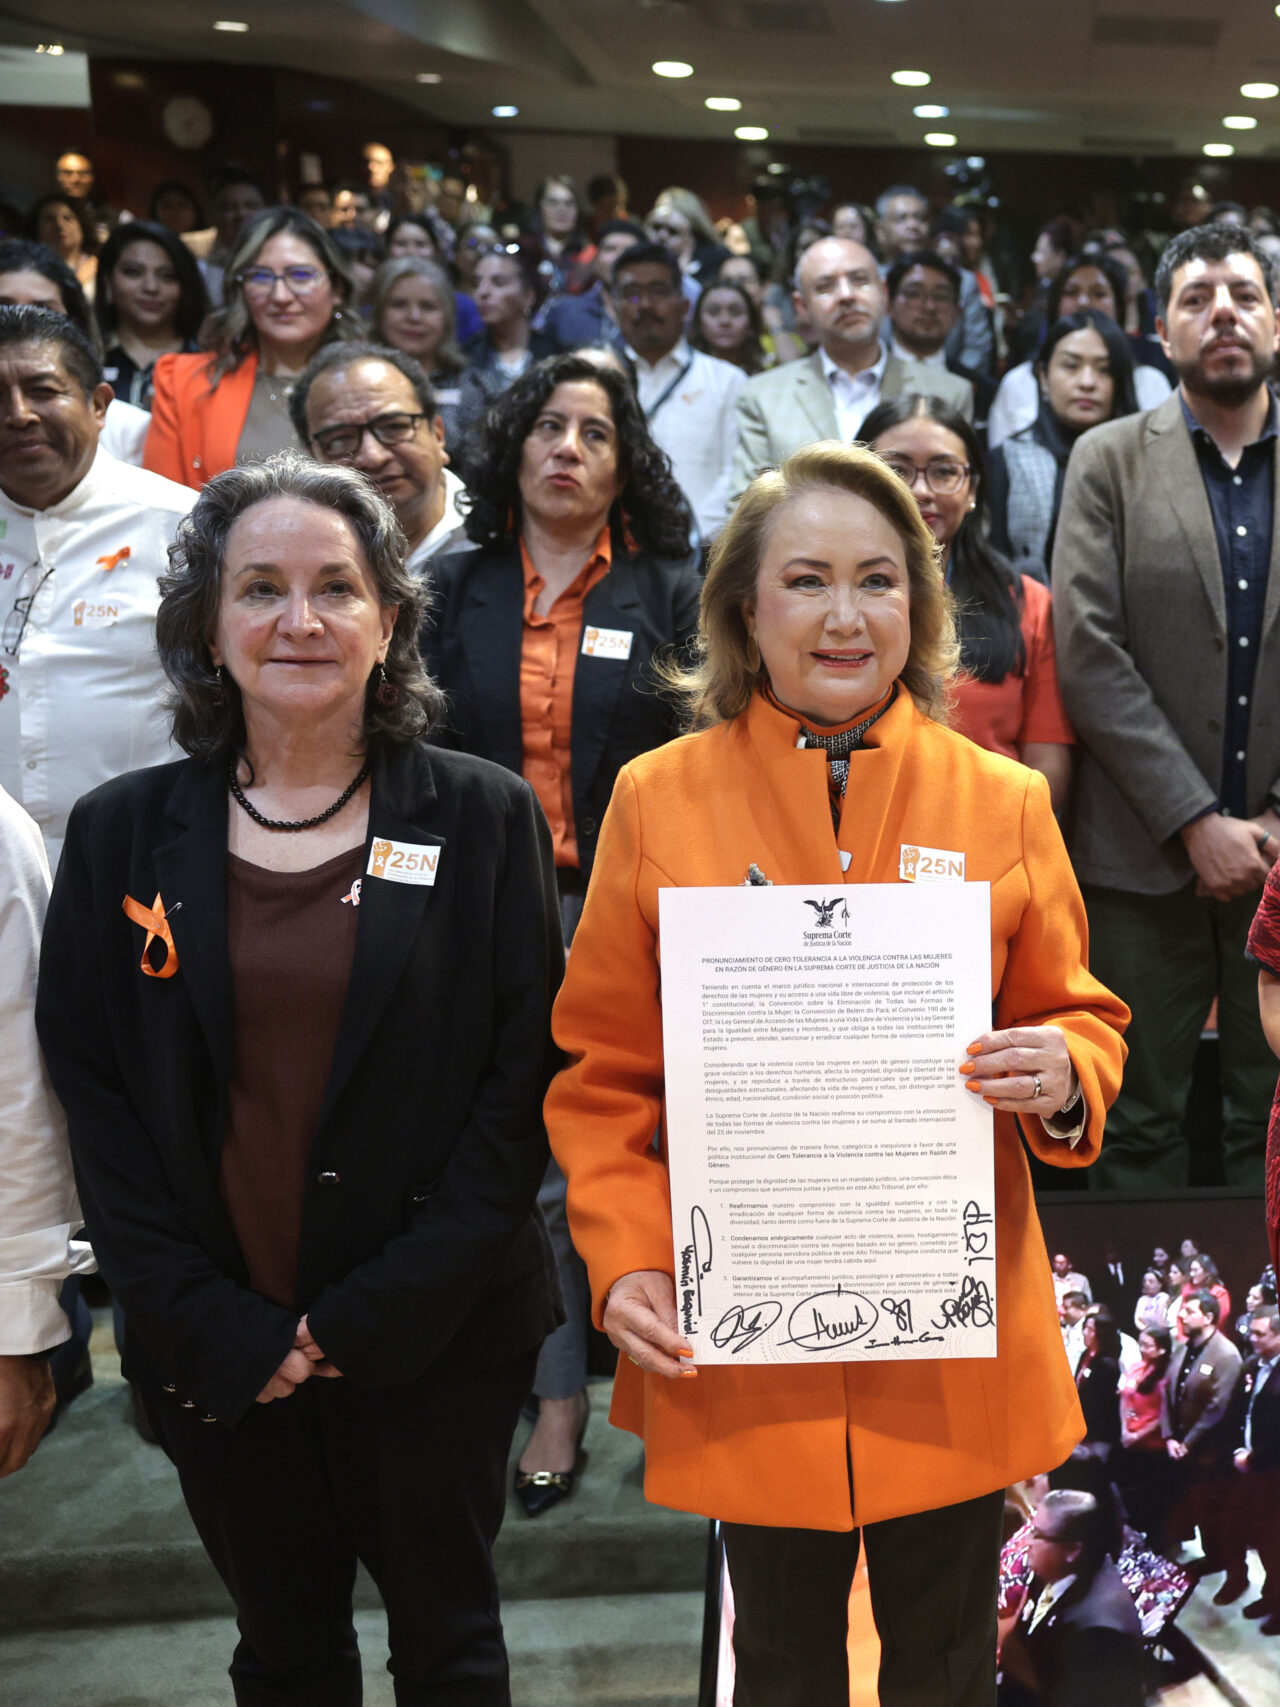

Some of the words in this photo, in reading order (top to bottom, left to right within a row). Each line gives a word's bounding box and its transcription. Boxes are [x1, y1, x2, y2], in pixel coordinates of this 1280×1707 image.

[87, 604, 119, 618] 25N
[599, 635, 630, 650] 25N
[390, 850, 438, 873] 25N
[920, 856, 963, 877] 25N
[803, 931, 833, 941] Suprema
[833, 931, 852, 939] Corte
[725, 965, 748, 973] RAZÓN
[757, 964, 783, 972] GÉNERO
[915, 961, 940, 969] NACIÓN
